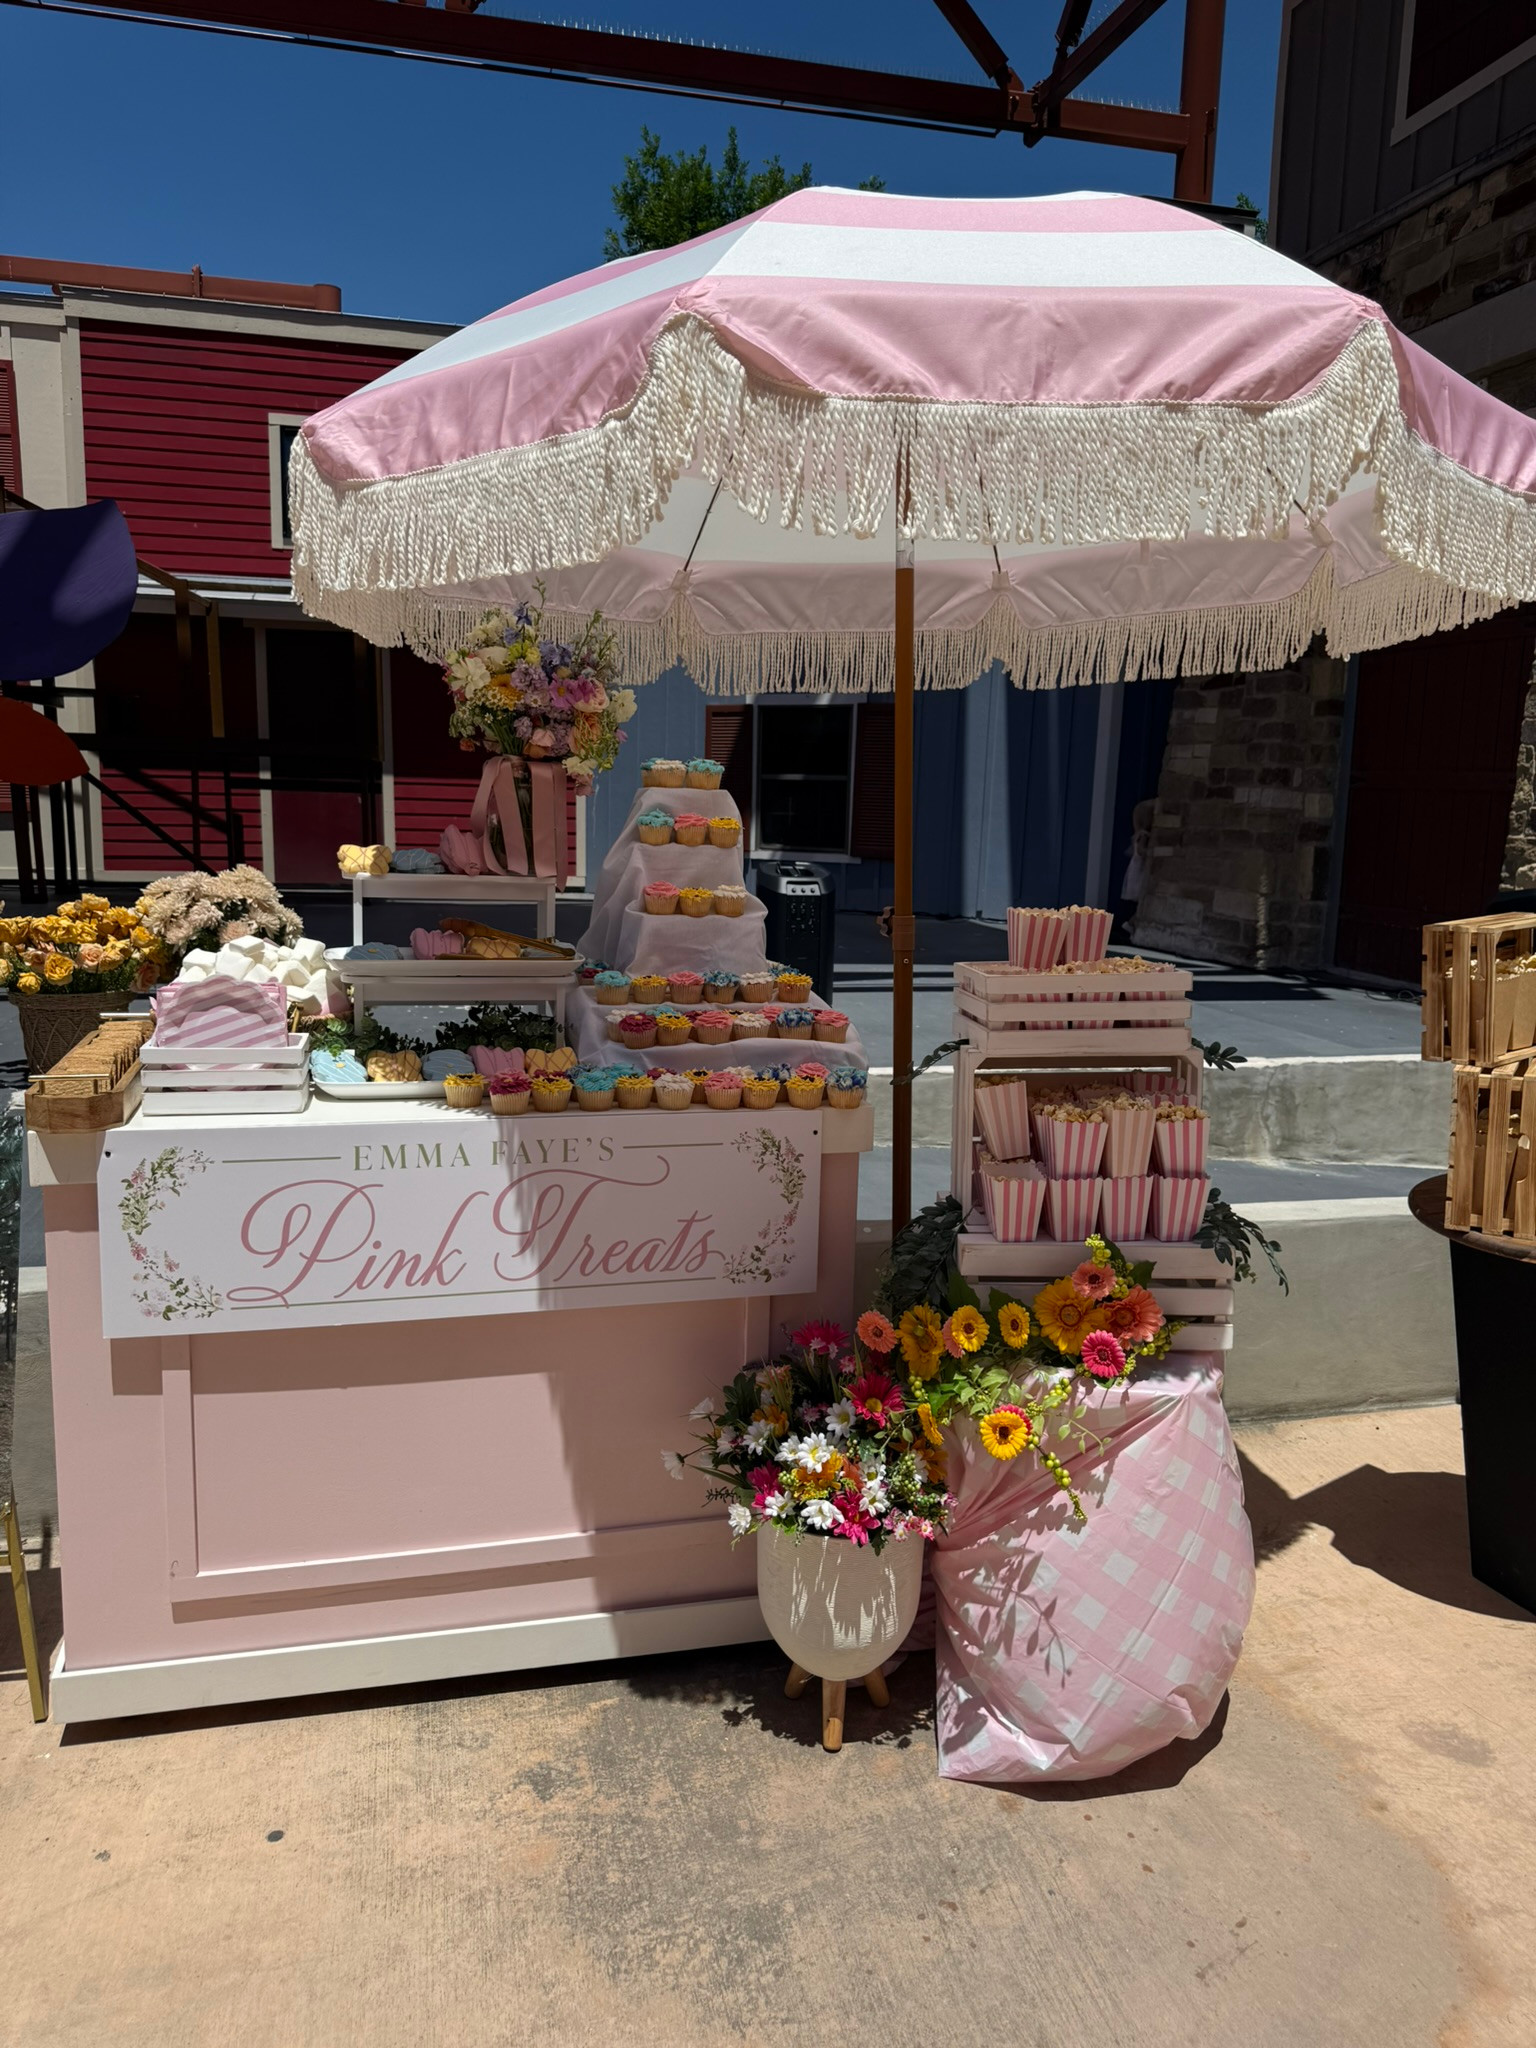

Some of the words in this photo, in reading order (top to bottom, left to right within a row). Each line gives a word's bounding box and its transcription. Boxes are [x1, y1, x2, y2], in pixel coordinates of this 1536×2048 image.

[353, 1142, 471, 1171] EMMA
[492, 1136, 614, 1165] FAYE'S
[226, 1179, 490, 1309] Pink
[493, 1155, 726, 1282] Treats
